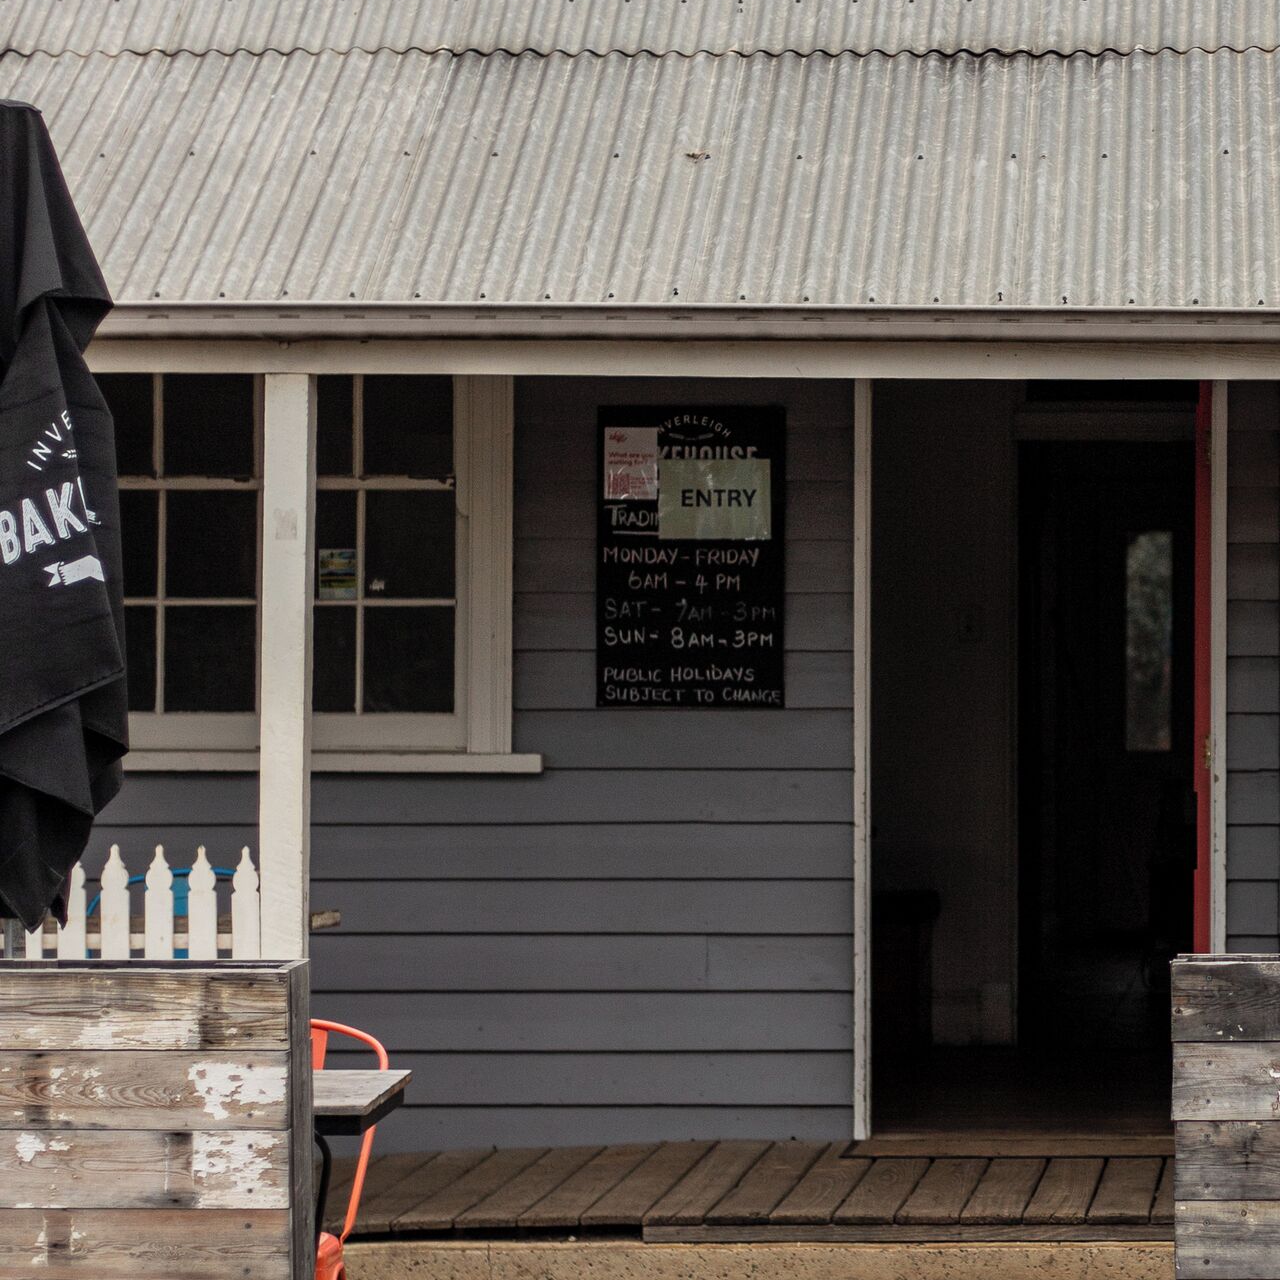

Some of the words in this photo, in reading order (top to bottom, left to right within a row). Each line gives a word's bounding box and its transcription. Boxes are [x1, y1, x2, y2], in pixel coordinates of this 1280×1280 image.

[681, 489, 757, 507] ENTRY
[603, 547, 678, 565] MONDAY
[696, 547, 760, 567] FRIDAY
[628, 570, 668, 590] 6AM
[695, 573, 708, 594] 4
[716, 574, 741, 591] PM
[605, 598, 647, 619] SAT
[604, 626, 645, 647] SUN
[604, 666, 662, 683] PUBLIC
[670, 664, 755, 682] HOLIDAYS
[605, 685, 686, 702] SUBJECT
[694, 688, 714, 702] TO
[722, 687, 782, 705] CHANGE
